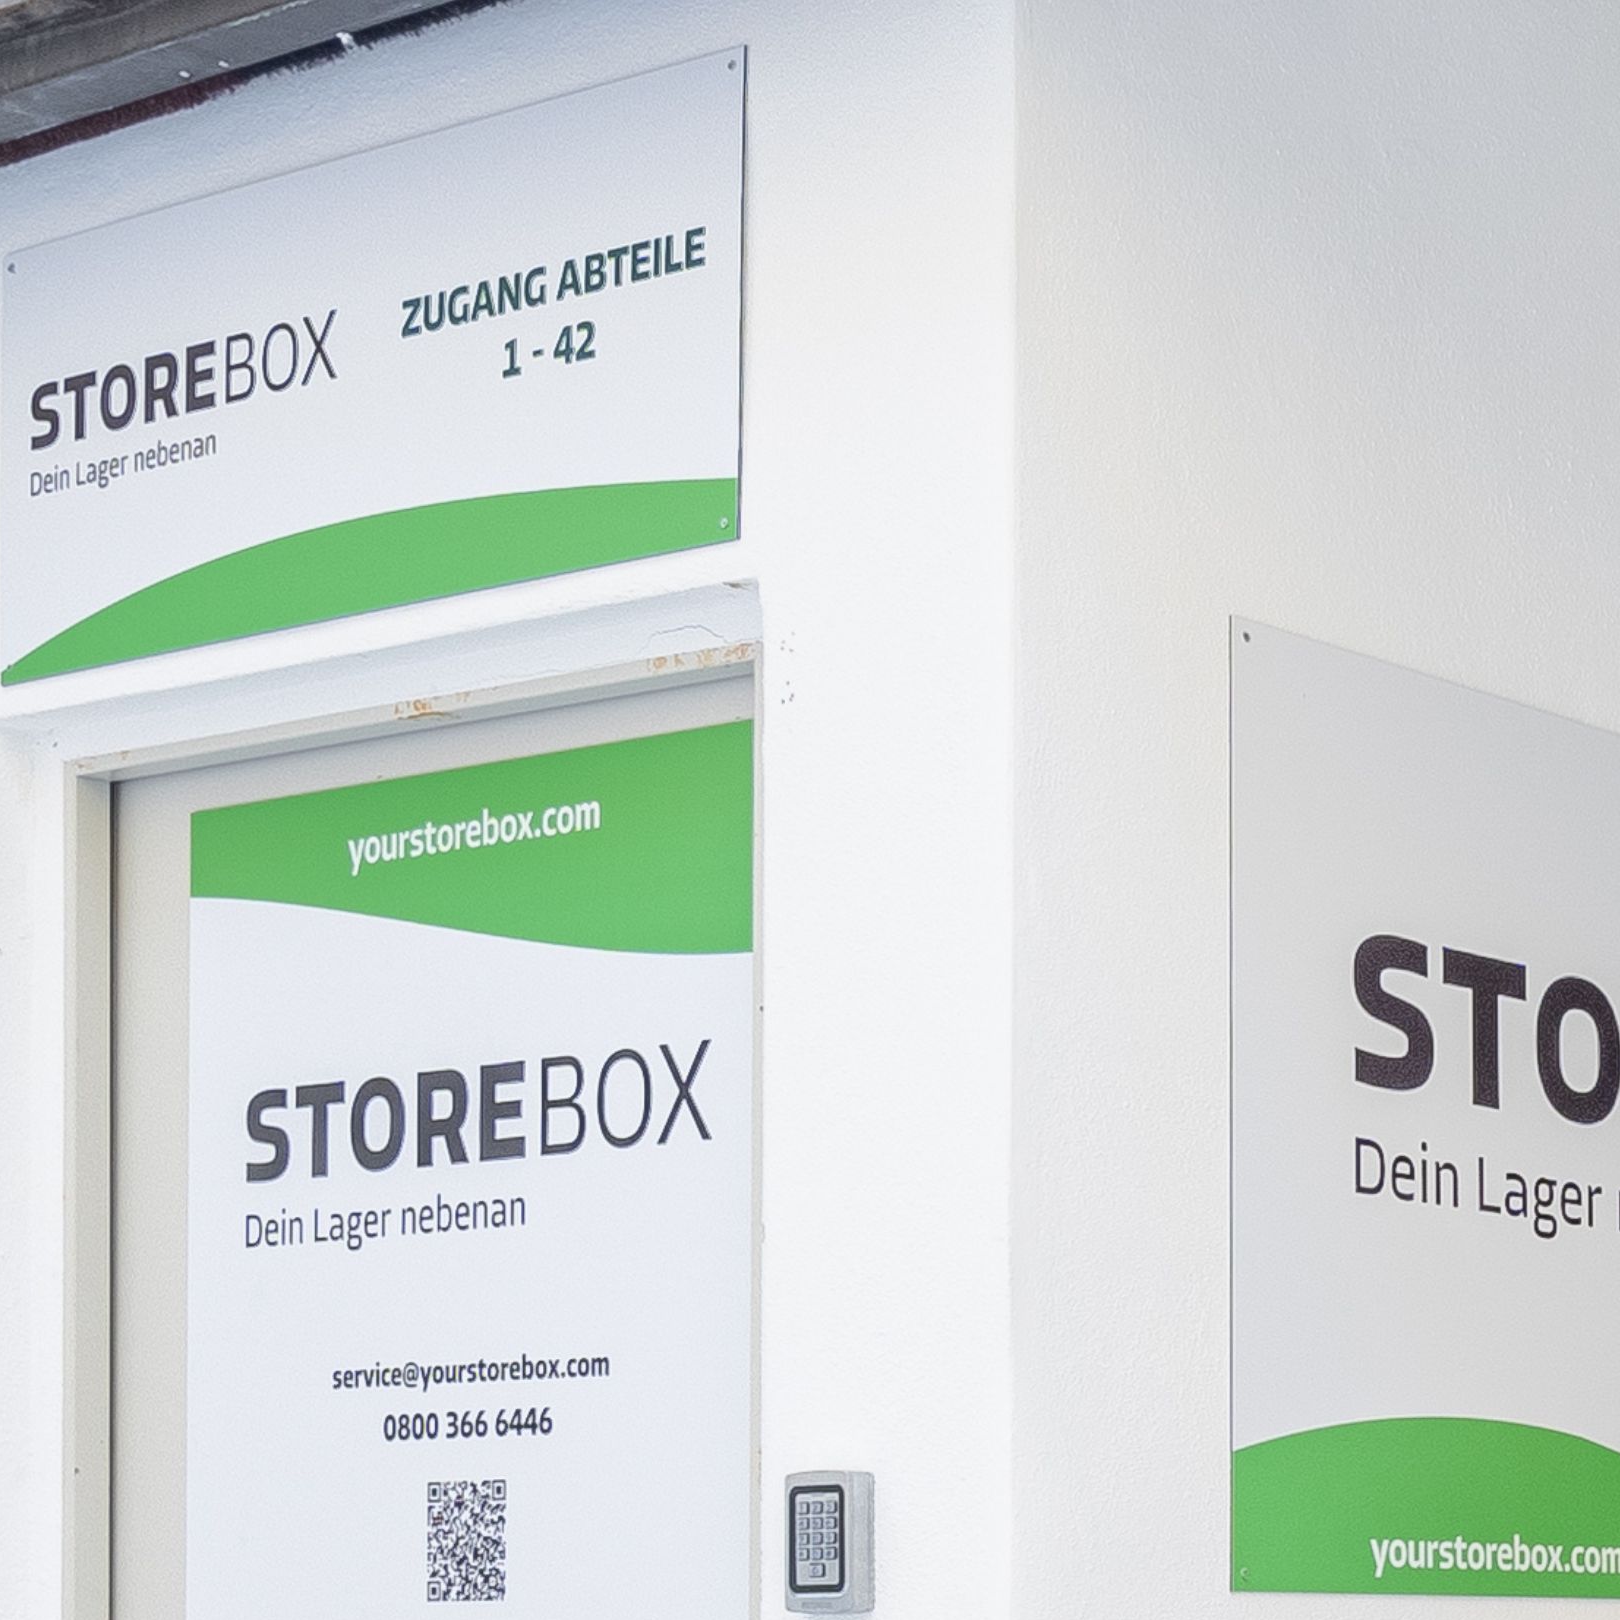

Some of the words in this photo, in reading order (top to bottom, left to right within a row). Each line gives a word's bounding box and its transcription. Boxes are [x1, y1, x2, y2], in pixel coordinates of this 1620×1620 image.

[402, 267, 546, 338] ZUGANG
[557, 227, 705, 300] ABTEILE
[31, 310, 336, 450] STOREBOX
[503, 339, 521, 378] 1
[554, 321, 595, 364] 42
[31, 465, 69, 496] Dein
[76, 456, 128, 488] Lager
[134, 435, 216, 472] nebenan
[348, 801, 600, 876] yourstorebox.com
[246, 1040, 711, 1182] STOREBOX
[246, 1208, 303, 1248] Dein
[315, 1209, 391, 1250] Lager
[402, 1194, 525, 1235] nebenan
[1356, 1137, 1458, 1207] Dein
[1479, 1157, 1602, 1239] Lager
[333, 1354, 609, 1392] service@yourstorebox.com
[384, 1413, 438, 1441] 0800
[446, 1410, 488, 1438] 366
[495, 1407, 552, 1436] 6446
